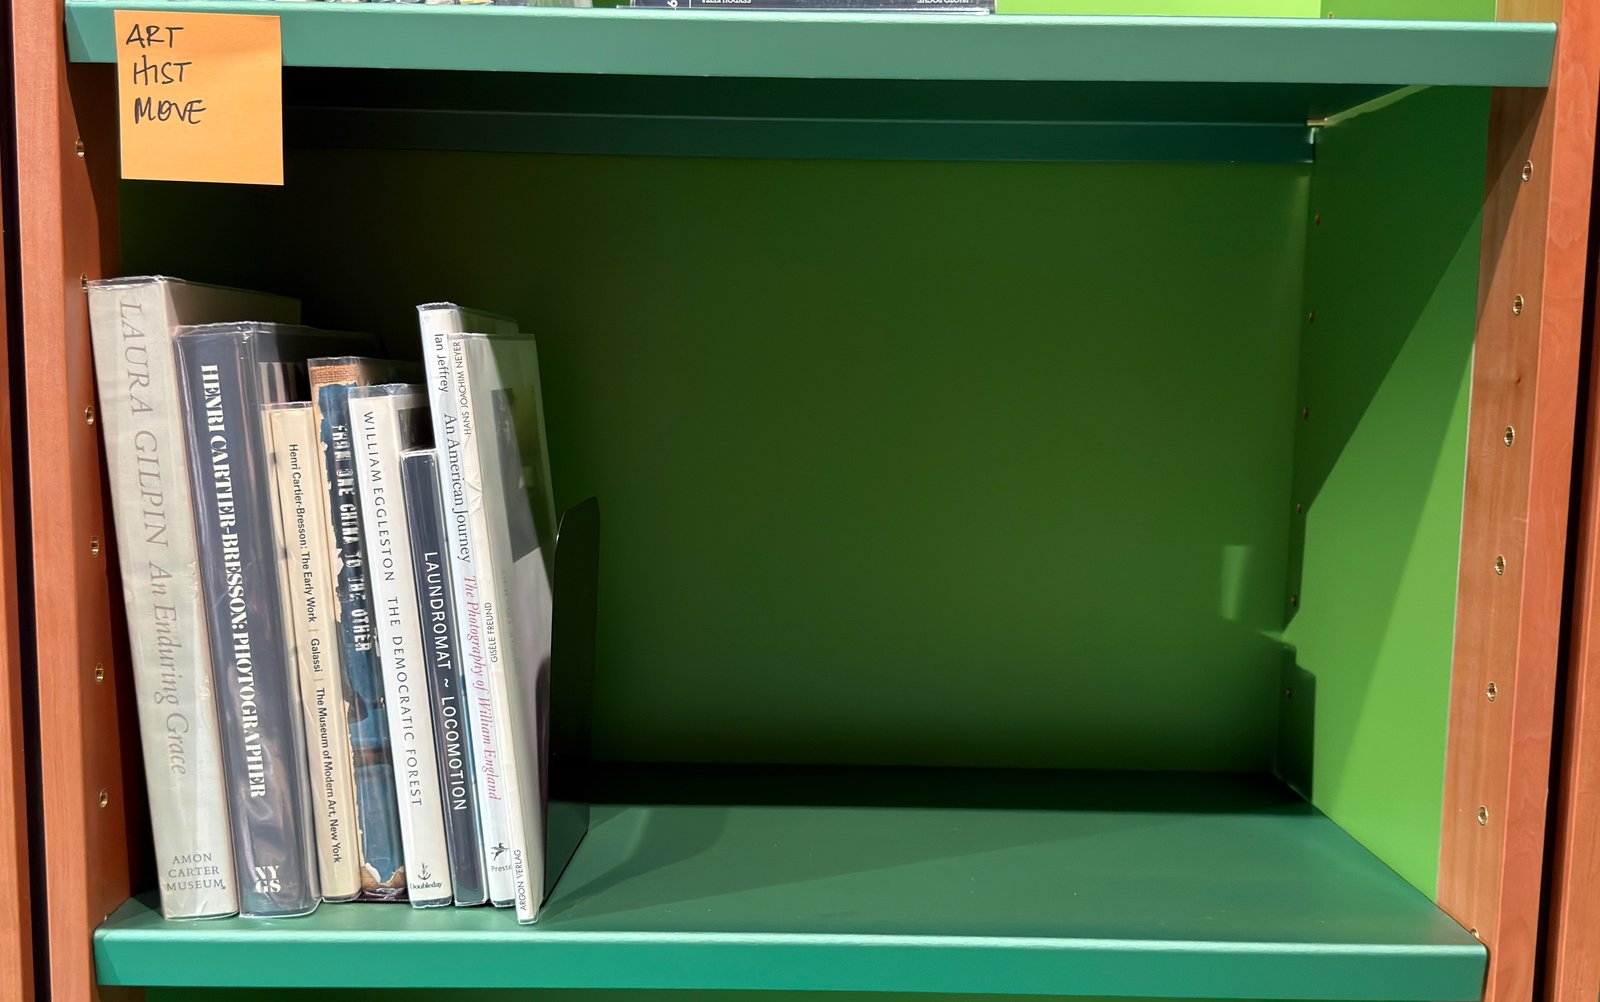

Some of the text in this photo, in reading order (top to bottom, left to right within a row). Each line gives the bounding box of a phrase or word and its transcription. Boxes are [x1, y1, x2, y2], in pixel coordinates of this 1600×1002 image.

[126, 24, 184, 48] ART
[133, 55, 192, 86] HIST
[134, 97, 206, 125] MOVE
[434, 333, 450, 393] Ian Jeffrey
[453, 341, 471, 435] HANS JOACHIM NEYER
[119, 299, 169, 548] LAURA GILPIN
[364, 411, 396, 581] WILLIAM EGGLESTON
[444, 413, 471, 563] An American Journey
[289, 444, 318, 623] Henri Cartier-Bresson: The Early Work
[340, 503, 360, 545] CHINA
[201, 364, 266, 798] HENRI CARTIER-BRESSON: PHOTOGRAPHER
[344, 551, 363, 568] TO
[348, 575, 367, 602] THE
[351, 608, 372, 651] OTHER
[485, 602, 495, 635] FREUND
[149, 560, 190, 776] An Enduring Grace
[310, 638, 323, 672] Galassi
[387, 597, 423, 806] THE DEMOCRATIC FOREST
[424, 551, 452, 669] LAUNDROMAT
[441, 696, 468, 811] LOCOMOTION
[464, 575, 502, 801] The Photography of William England
[316, 687, 342, 863] The Museum of Modern Art, New York
[168, 866, 220, 879] CARTER
[172, 853, 212, 865] AMON
[255, 865, 281, 880] NY
[513, 849, 527, 911] ARGON VERLAG
[255, 879, 281, 893] GS
[410, 881, 443, 891] Doubleday
